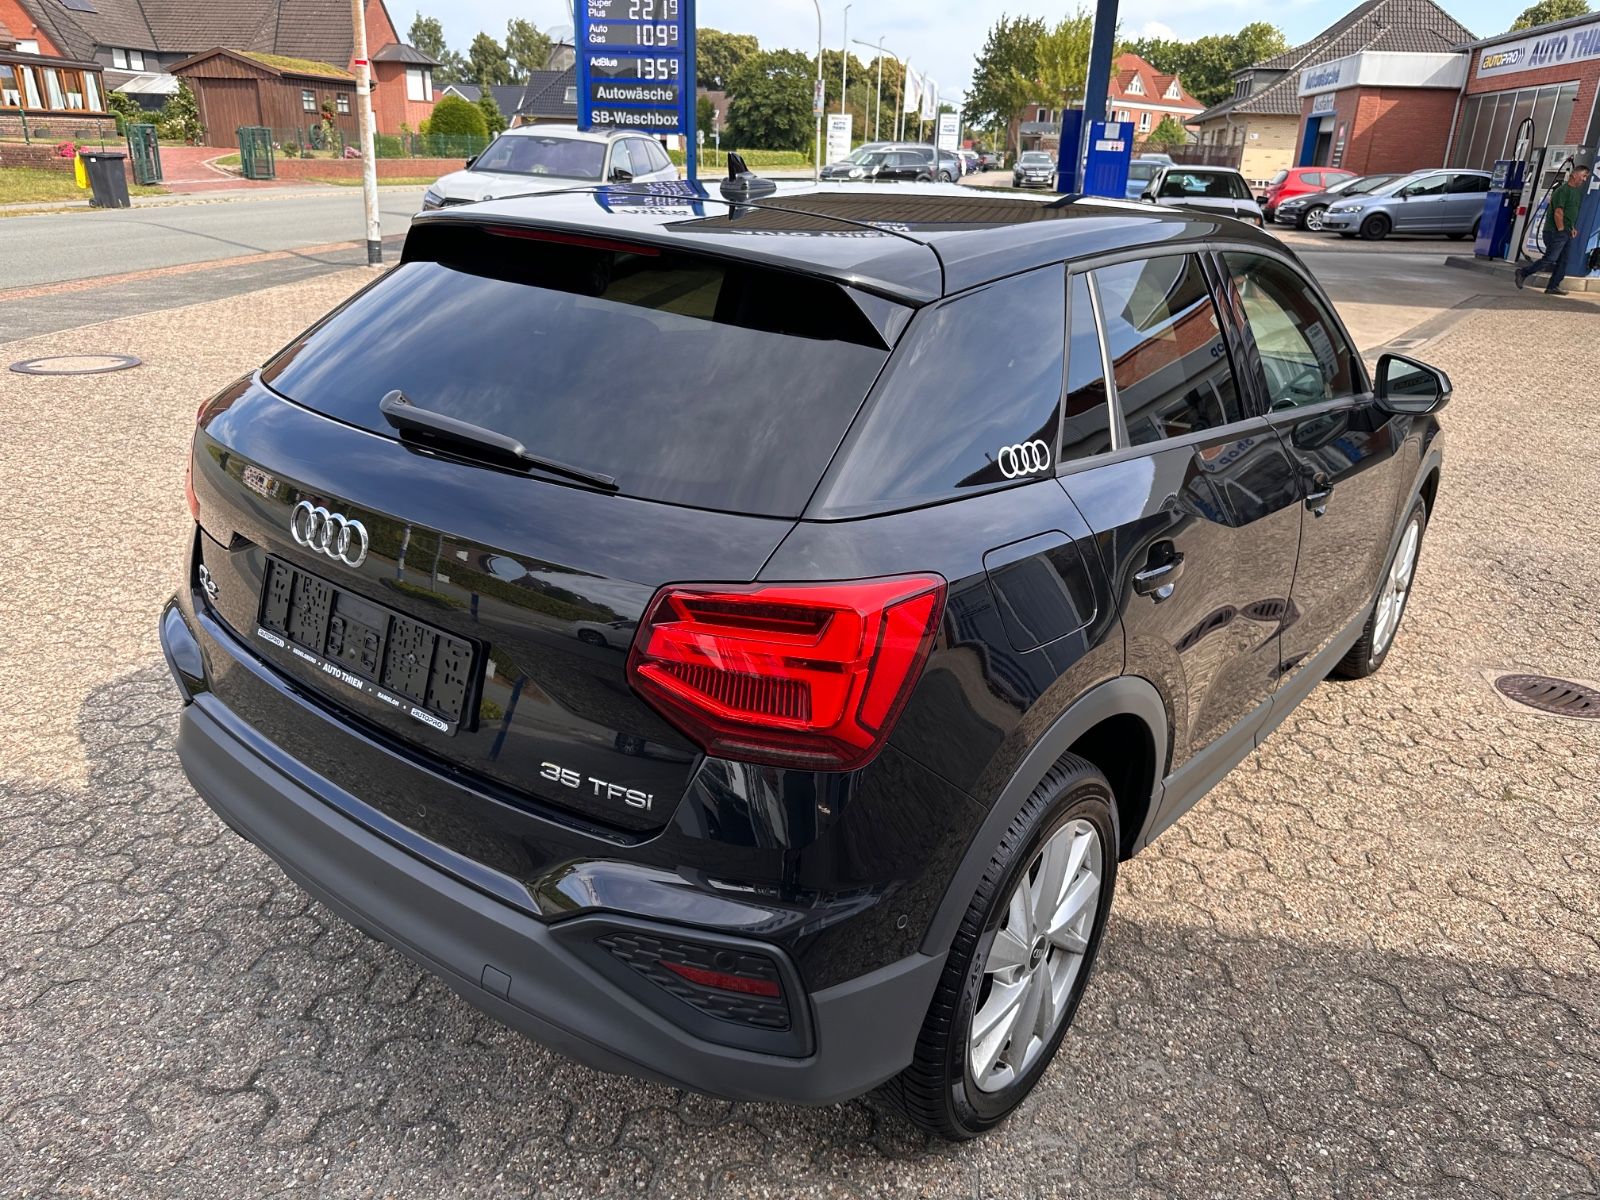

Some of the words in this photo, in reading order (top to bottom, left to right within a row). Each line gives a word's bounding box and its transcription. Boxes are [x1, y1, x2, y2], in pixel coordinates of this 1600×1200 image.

[588, 0, 612, 8] Super
[588, 8, 606, 18] Plus
[589, 24, 608, 33] Auto
[589, 34, 606, 43] Gas
[1527, 35, 1568, 66] AUTO
[590, 57, 618, 67] AdBlue
[597, 86, 673, 101] Autowäsche
[591, 110, 679, 126] SB-Waschbox
[322, 662, 341, 678] AUTO
[341, 671, 364, 690] THIEN
[539, 761, 581, 789] 35
[588, 776, 654, 811] TFSI
